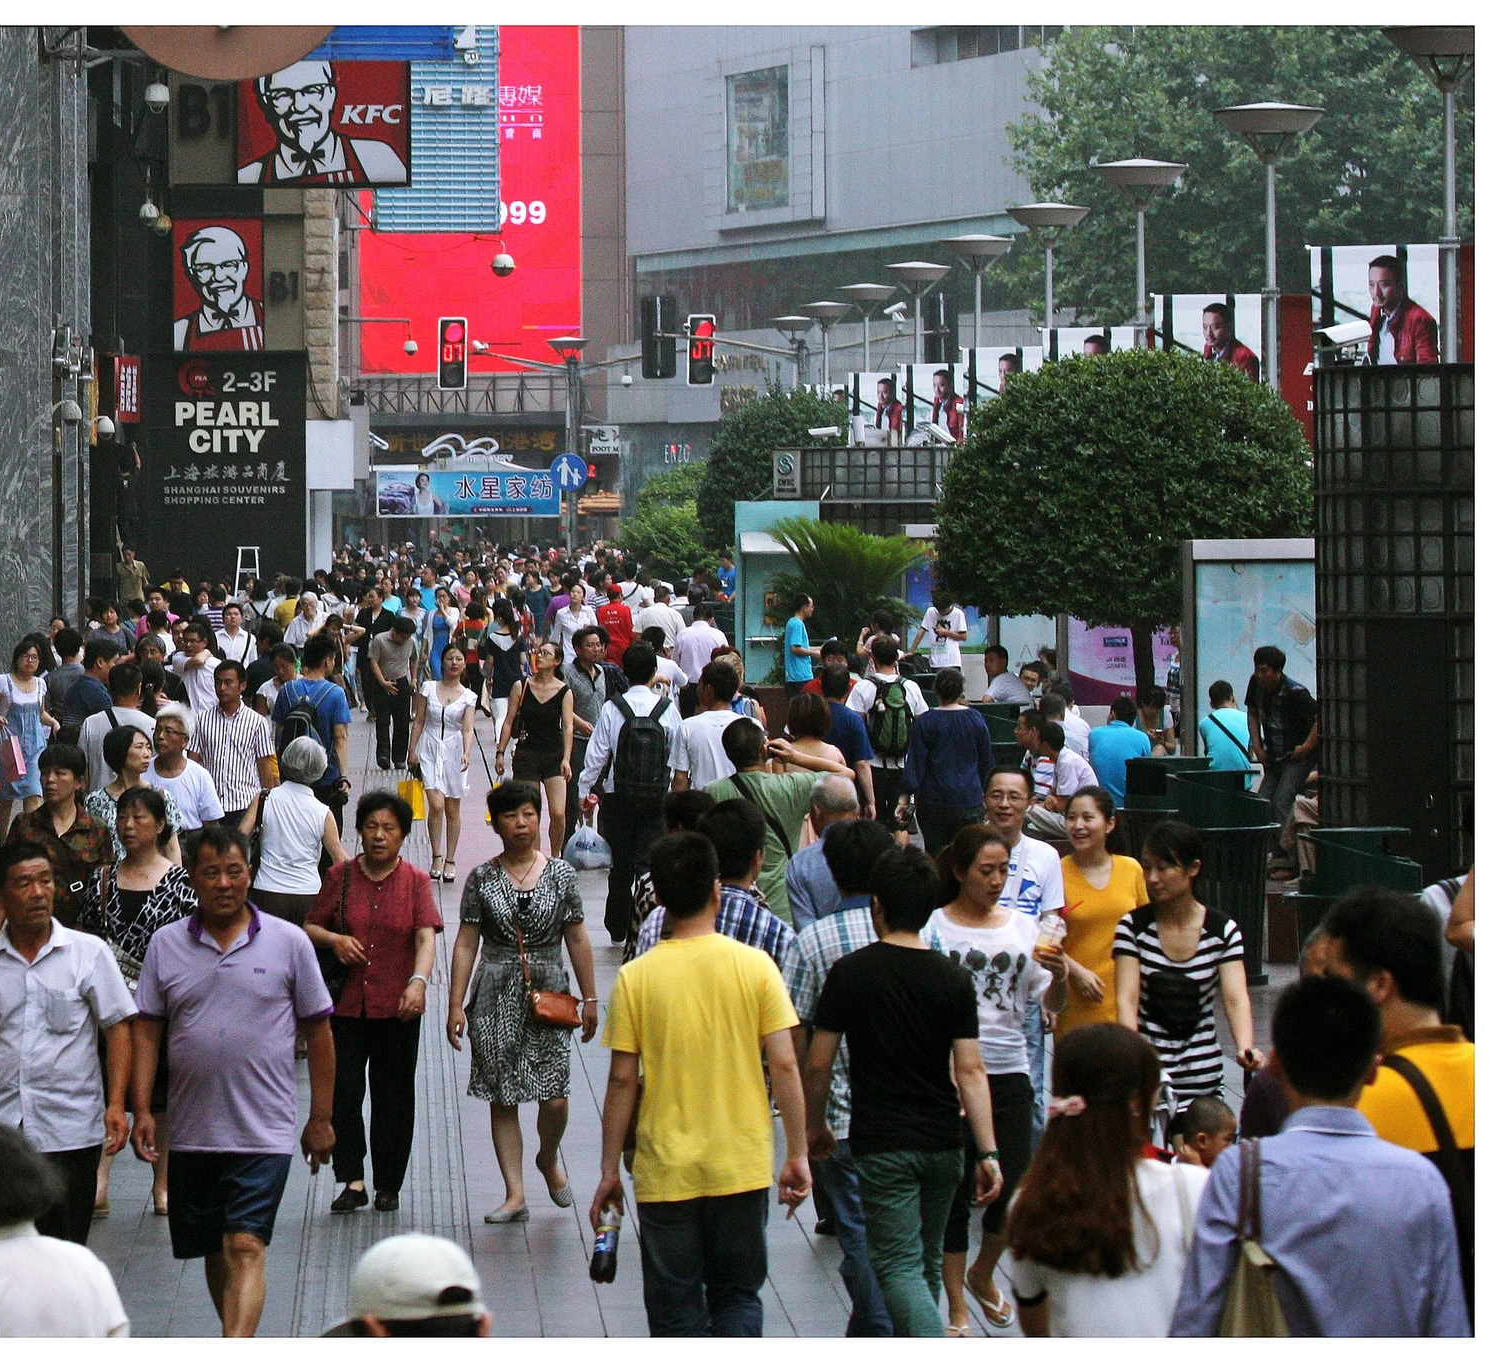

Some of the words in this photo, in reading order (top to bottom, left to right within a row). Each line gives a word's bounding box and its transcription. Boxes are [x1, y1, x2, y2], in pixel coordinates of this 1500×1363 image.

[411, 84, 492, 105] 尼路
[179, 83, 230, 139] B1
[340, 104, 402, 125] KFC
[270, 270, 299, 301] B1
[443, 343, 463, 363] 07
[222, 371, 277, 392] 2-3F
[175, 401, 279, 426] PEARL
[189, 428, 266, 453] CITY
[164, 486, 221, 494] SHANGHAI
[223, 486, 286, 494] SOUVENIRS
[454, 474, 553, 500] 水星家纺
[164, 496, 220, 504] SHOPPING
[222, 496, 265, 504] CENTER
